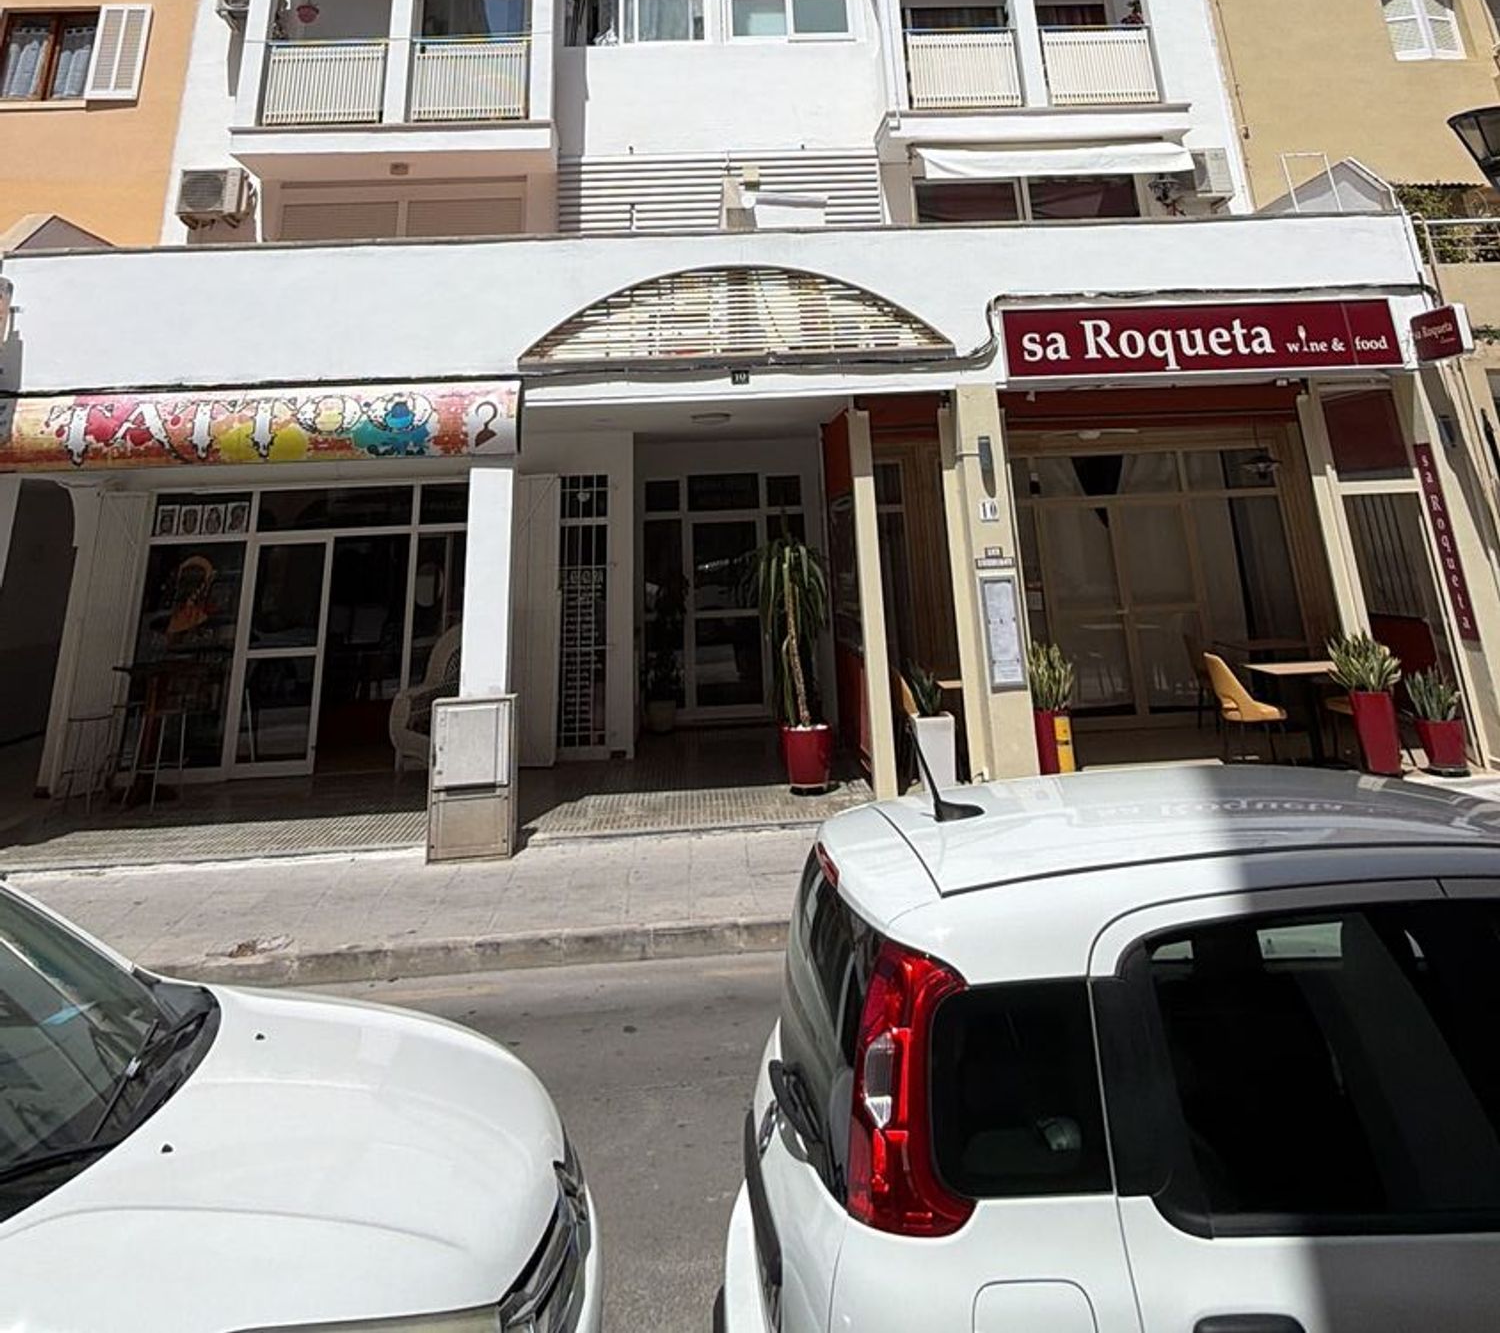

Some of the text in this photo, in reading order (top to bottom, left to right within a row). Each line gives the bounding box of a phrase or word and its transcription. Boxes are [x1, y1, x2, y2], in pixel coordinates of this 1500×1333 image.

[1022, 318, 1389, 370] sa Roqueta wine & food
[735, 372, 747, 382] 10
[47, 392, 436, 466] TATTOO
[982, 501, 997, 518] 10
[1421, 455, 1471, 629] sa Roqueta
